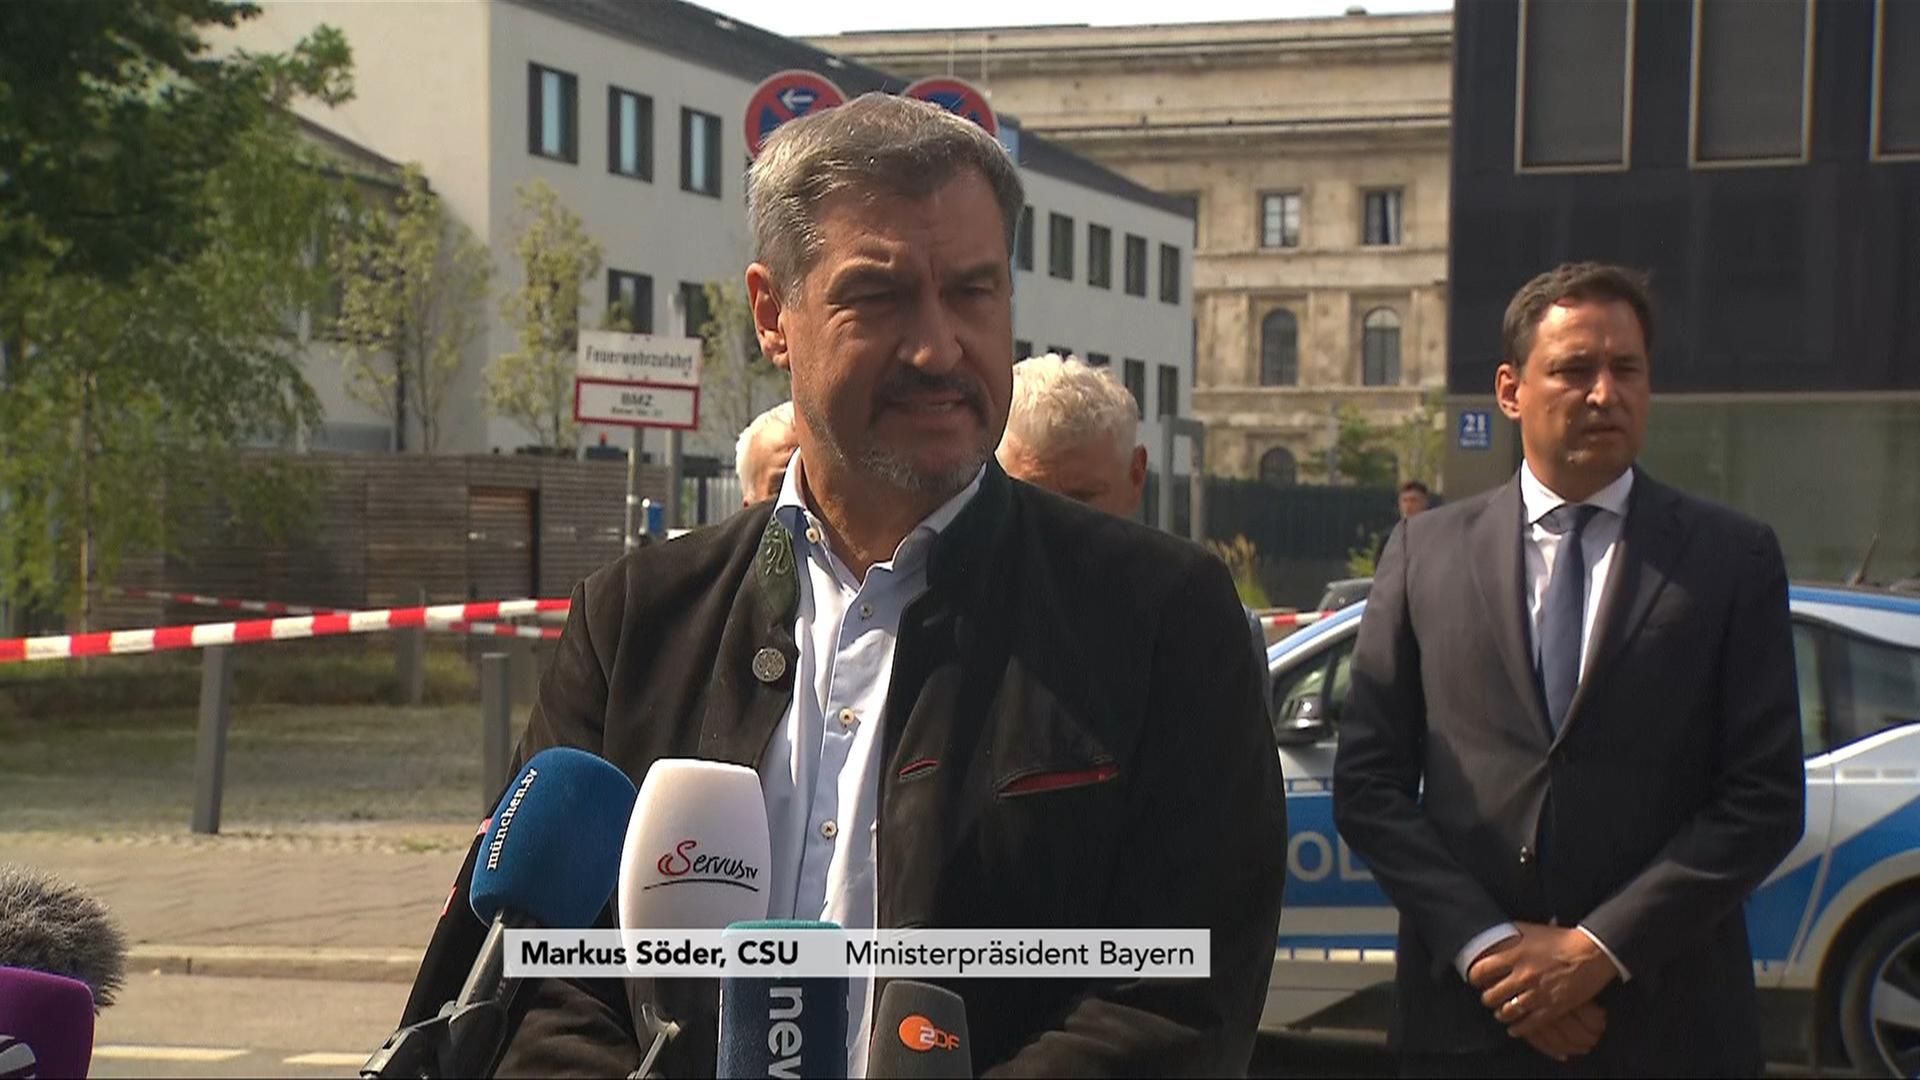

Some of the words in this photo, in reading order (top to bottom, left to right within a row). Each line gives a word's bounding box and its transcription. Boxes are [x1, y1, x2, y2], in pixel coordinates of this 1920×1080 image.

[585, 345, 693, 370] Feuerwehrzufahrt
[1463, 413, 1486, 432] 21
[487, 767, 538, 871] münchen.tv
[919, 1025, 961, 1051] ZDF
